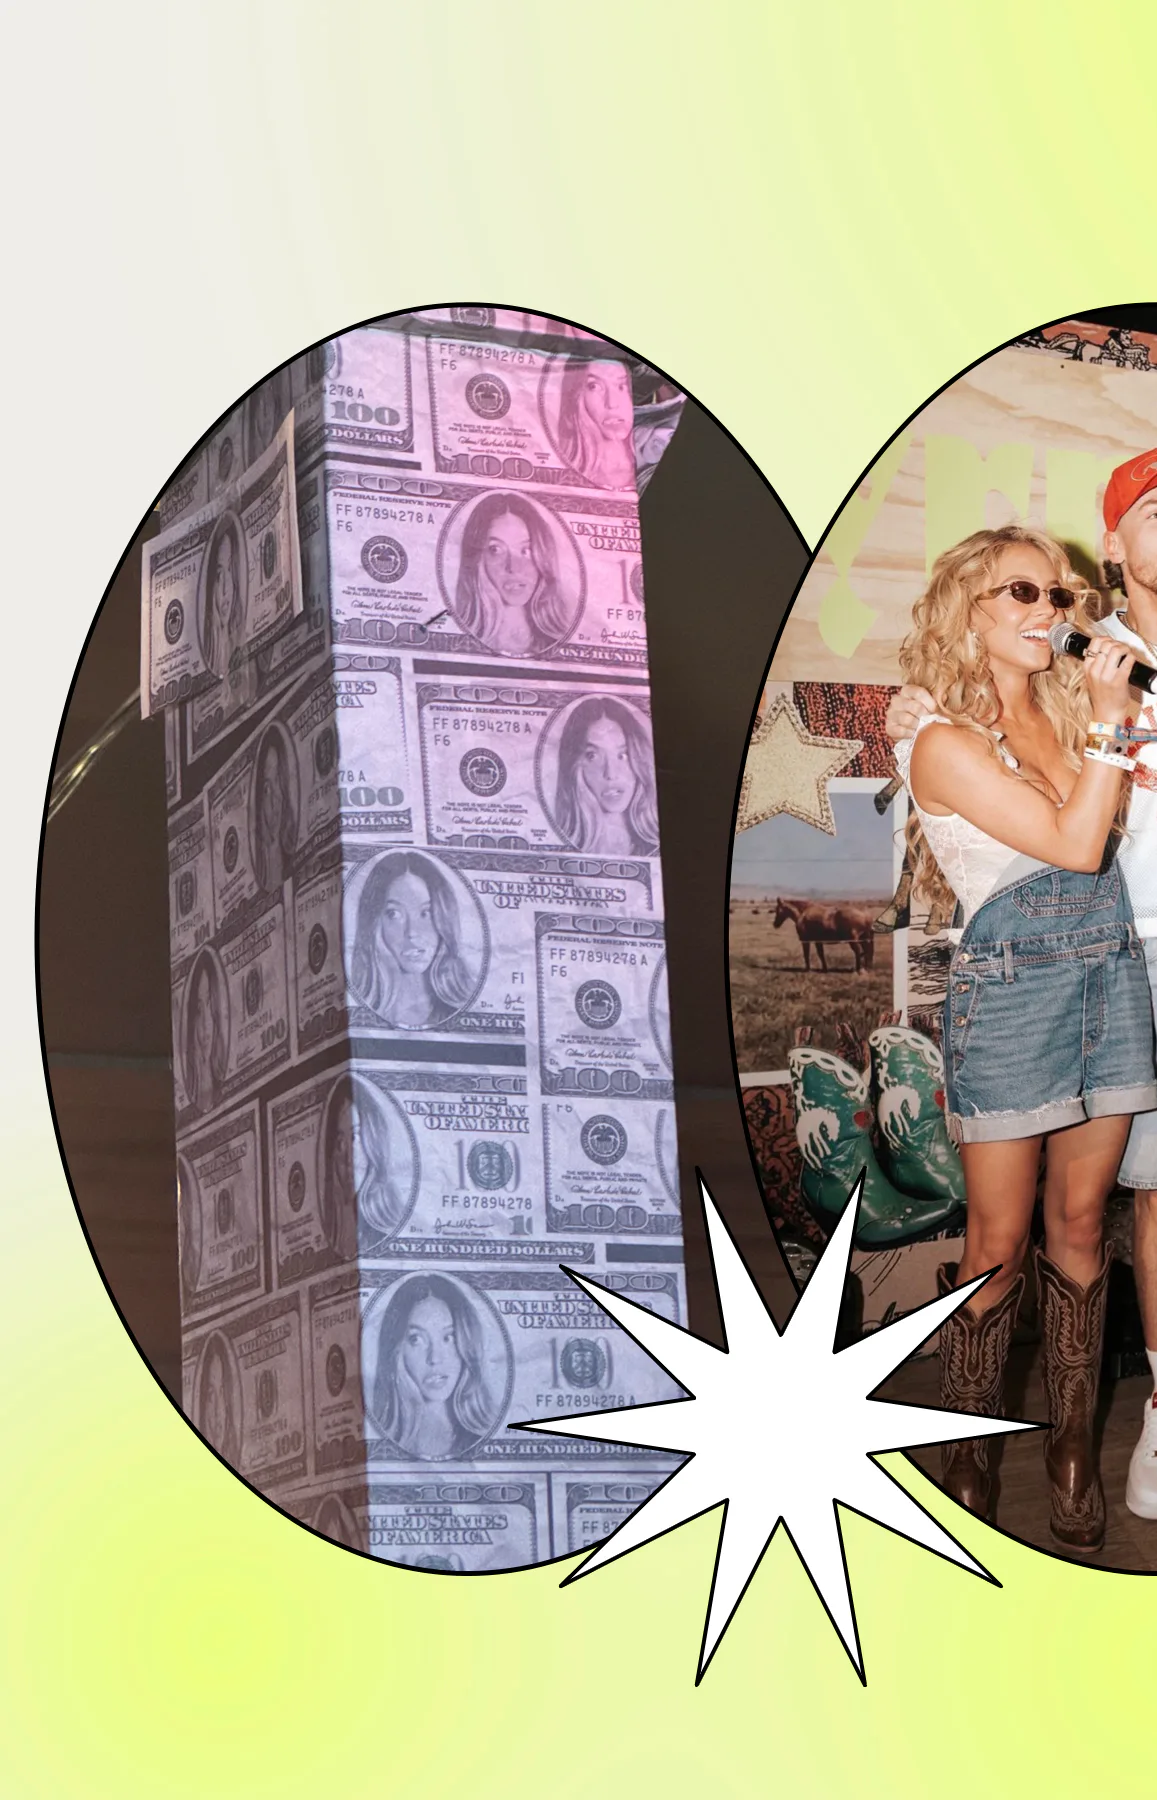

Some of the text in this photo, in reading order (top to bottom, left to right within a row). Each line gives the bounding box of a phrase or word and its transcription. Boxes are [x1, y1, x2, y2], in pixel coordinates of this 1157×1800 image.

[439, 343, 537, 366] FF 87894278 A
[441, 358, 457, 371] F6
[330, 401, 401, 427] 100
[332, 428, 404, 446] DOLLARS
[336, 504, 435, 525] FF 87894278 A
[336, 520, 353, 532] F6
[607, 608, 623, 621] FF
[433, 717, 532, 734] FF 87894278 A
[434, 734, 450, 747] F6
[358, 771, 366, 783] A
[473, 880, 626, 902] UNITED STATES
[550, 948, 648, 965] FF 87894278 A
[551, 965, 567, 977] F6
[442, 1195, 533, 1210] FF 87894278
[389, 1242, 585, 1258] ONE HUNDRED DOLLARS
[536, 1395, 552, 1408] FF
[556, 1395, 626, 1408] 87894278
[484, 1443, 518, 1455] ONE
[519, 1443, 600, 1456] HUNDRED
[433, 1515, 508, 1530] STATES
[582, 1521, 599, 1533] FF
[393, 1531, 494, 1545] AMERICA
